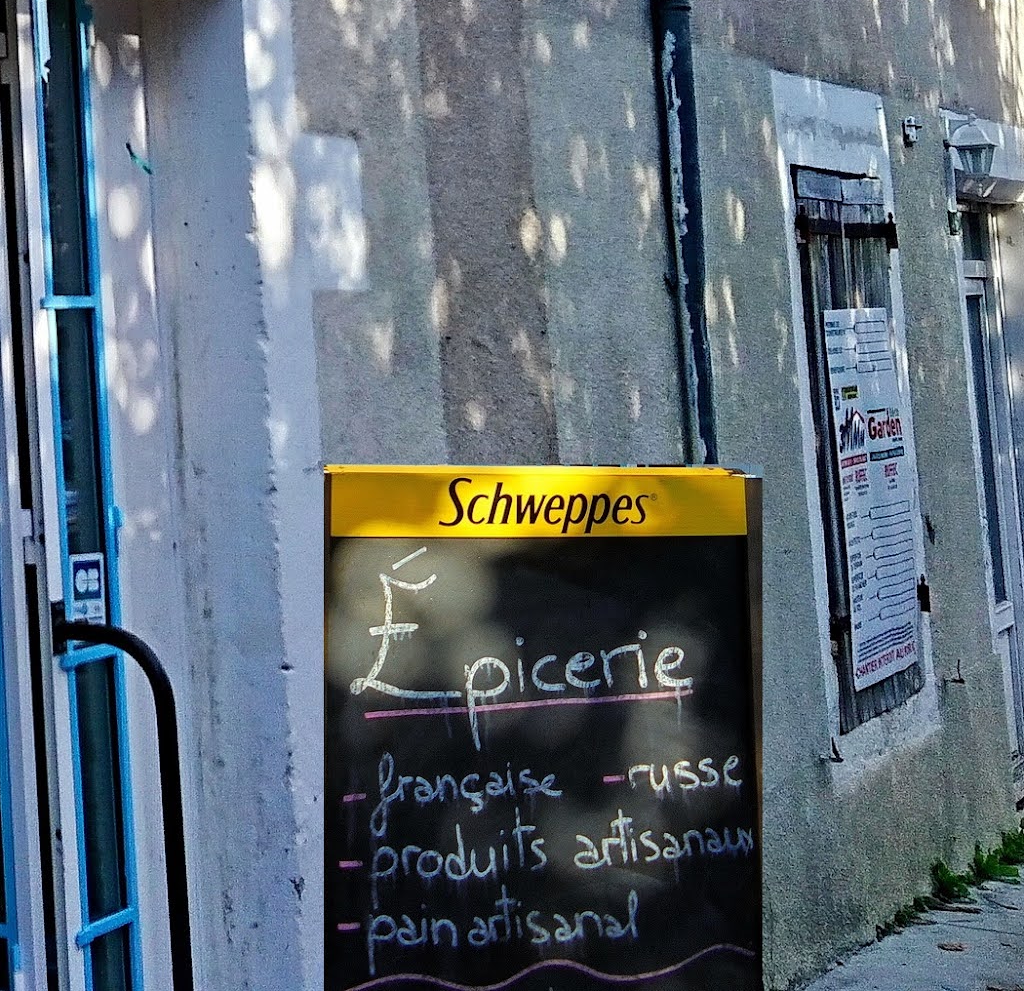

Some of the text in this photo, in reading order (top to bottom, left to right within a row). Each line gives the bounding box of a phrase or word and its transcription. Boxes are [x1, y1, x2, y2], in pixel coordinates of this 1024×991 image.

[868, 417, 902, 440] Garden
[438, 477, 650, 534] Schweppes
[349, 546, 693, 750] Épicerie
[369, 752, 743, 836] française russe
[370, 806, 548, 910] produits
[364, 885, 640, 975] pain artisanal
